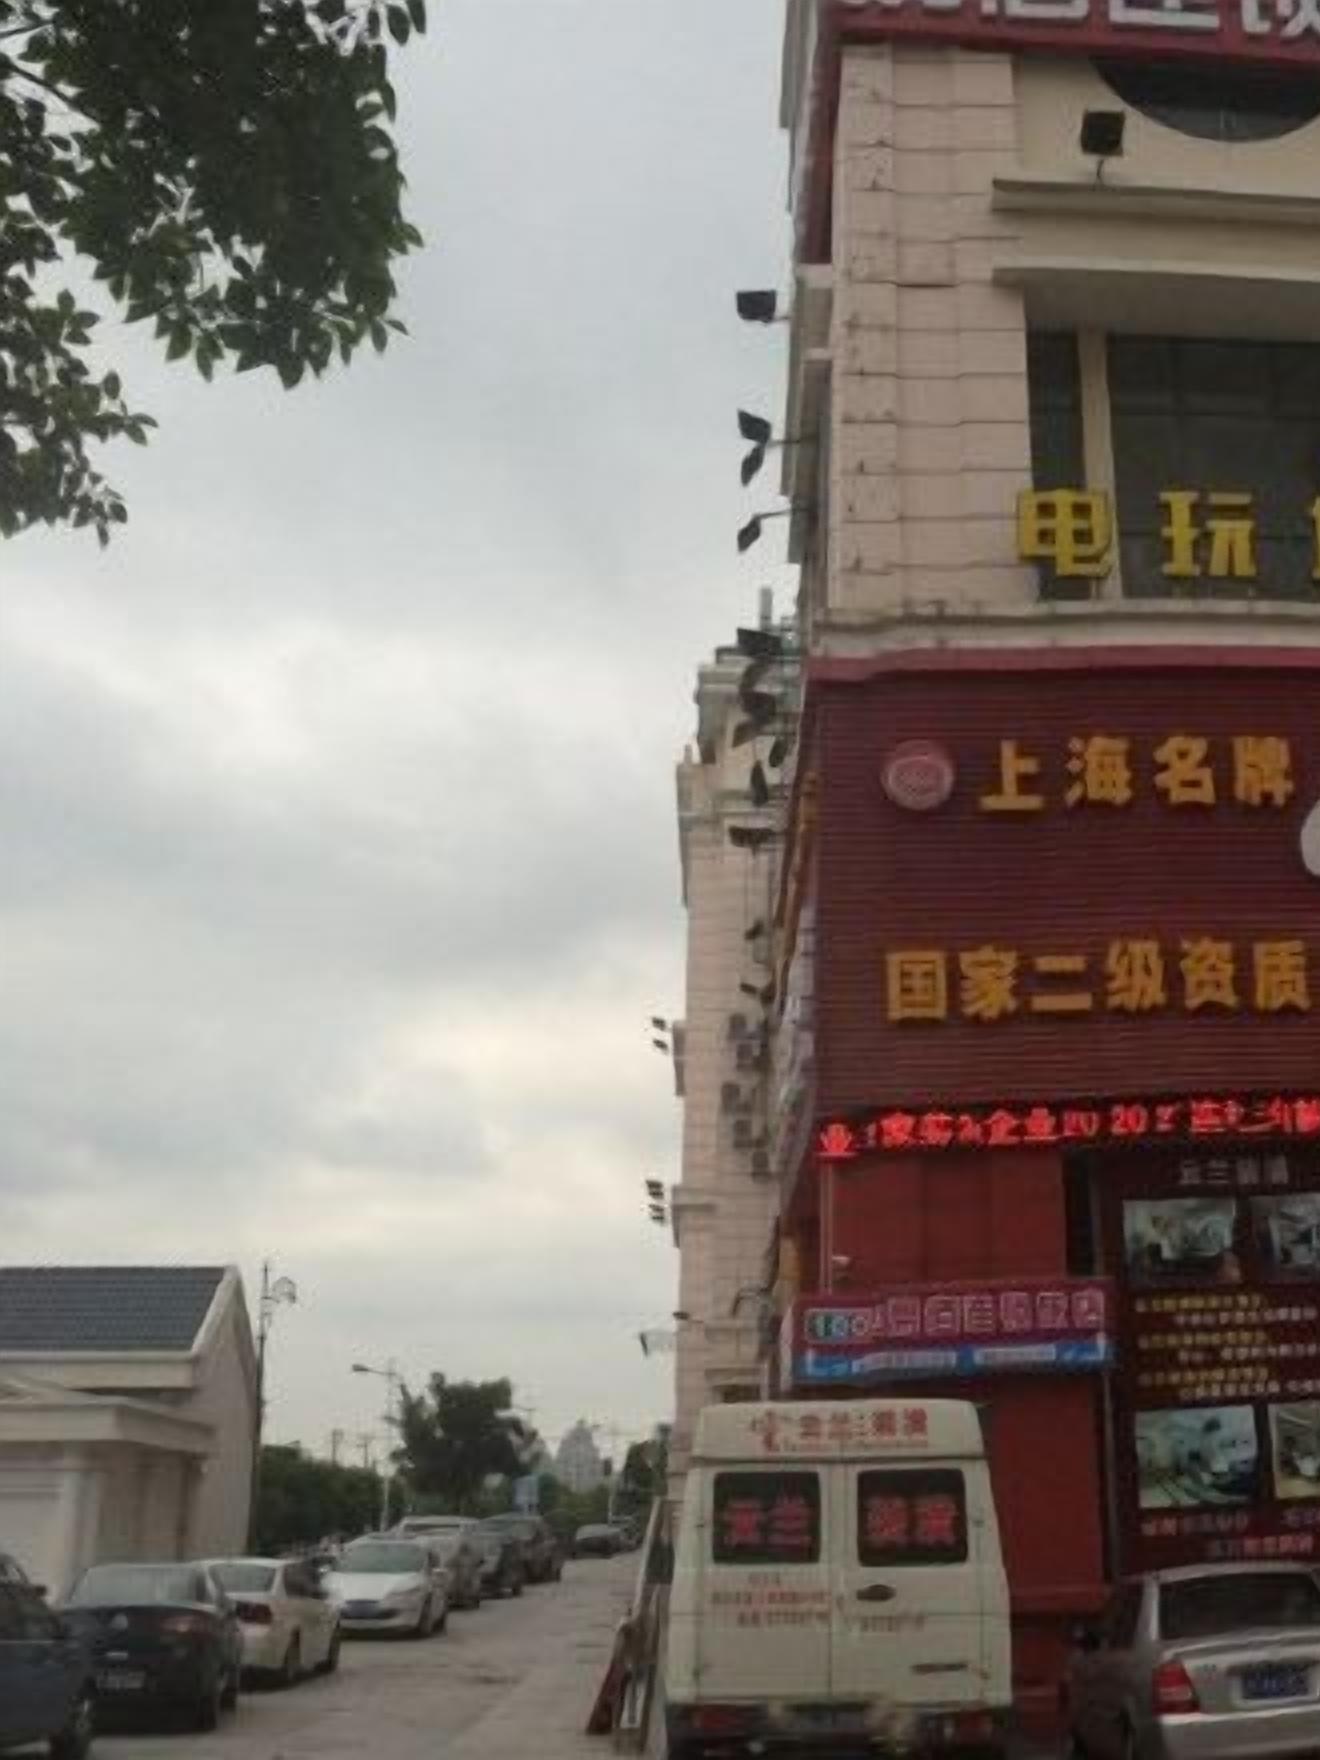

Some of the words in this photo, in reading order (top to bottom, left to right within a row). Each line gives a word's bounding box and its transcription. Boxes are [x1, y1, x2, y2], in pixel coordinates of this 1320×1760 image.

[978, 735, 1294, 812] 上海名牌
[885, 935, 1312, 1022] 国家二级资质
